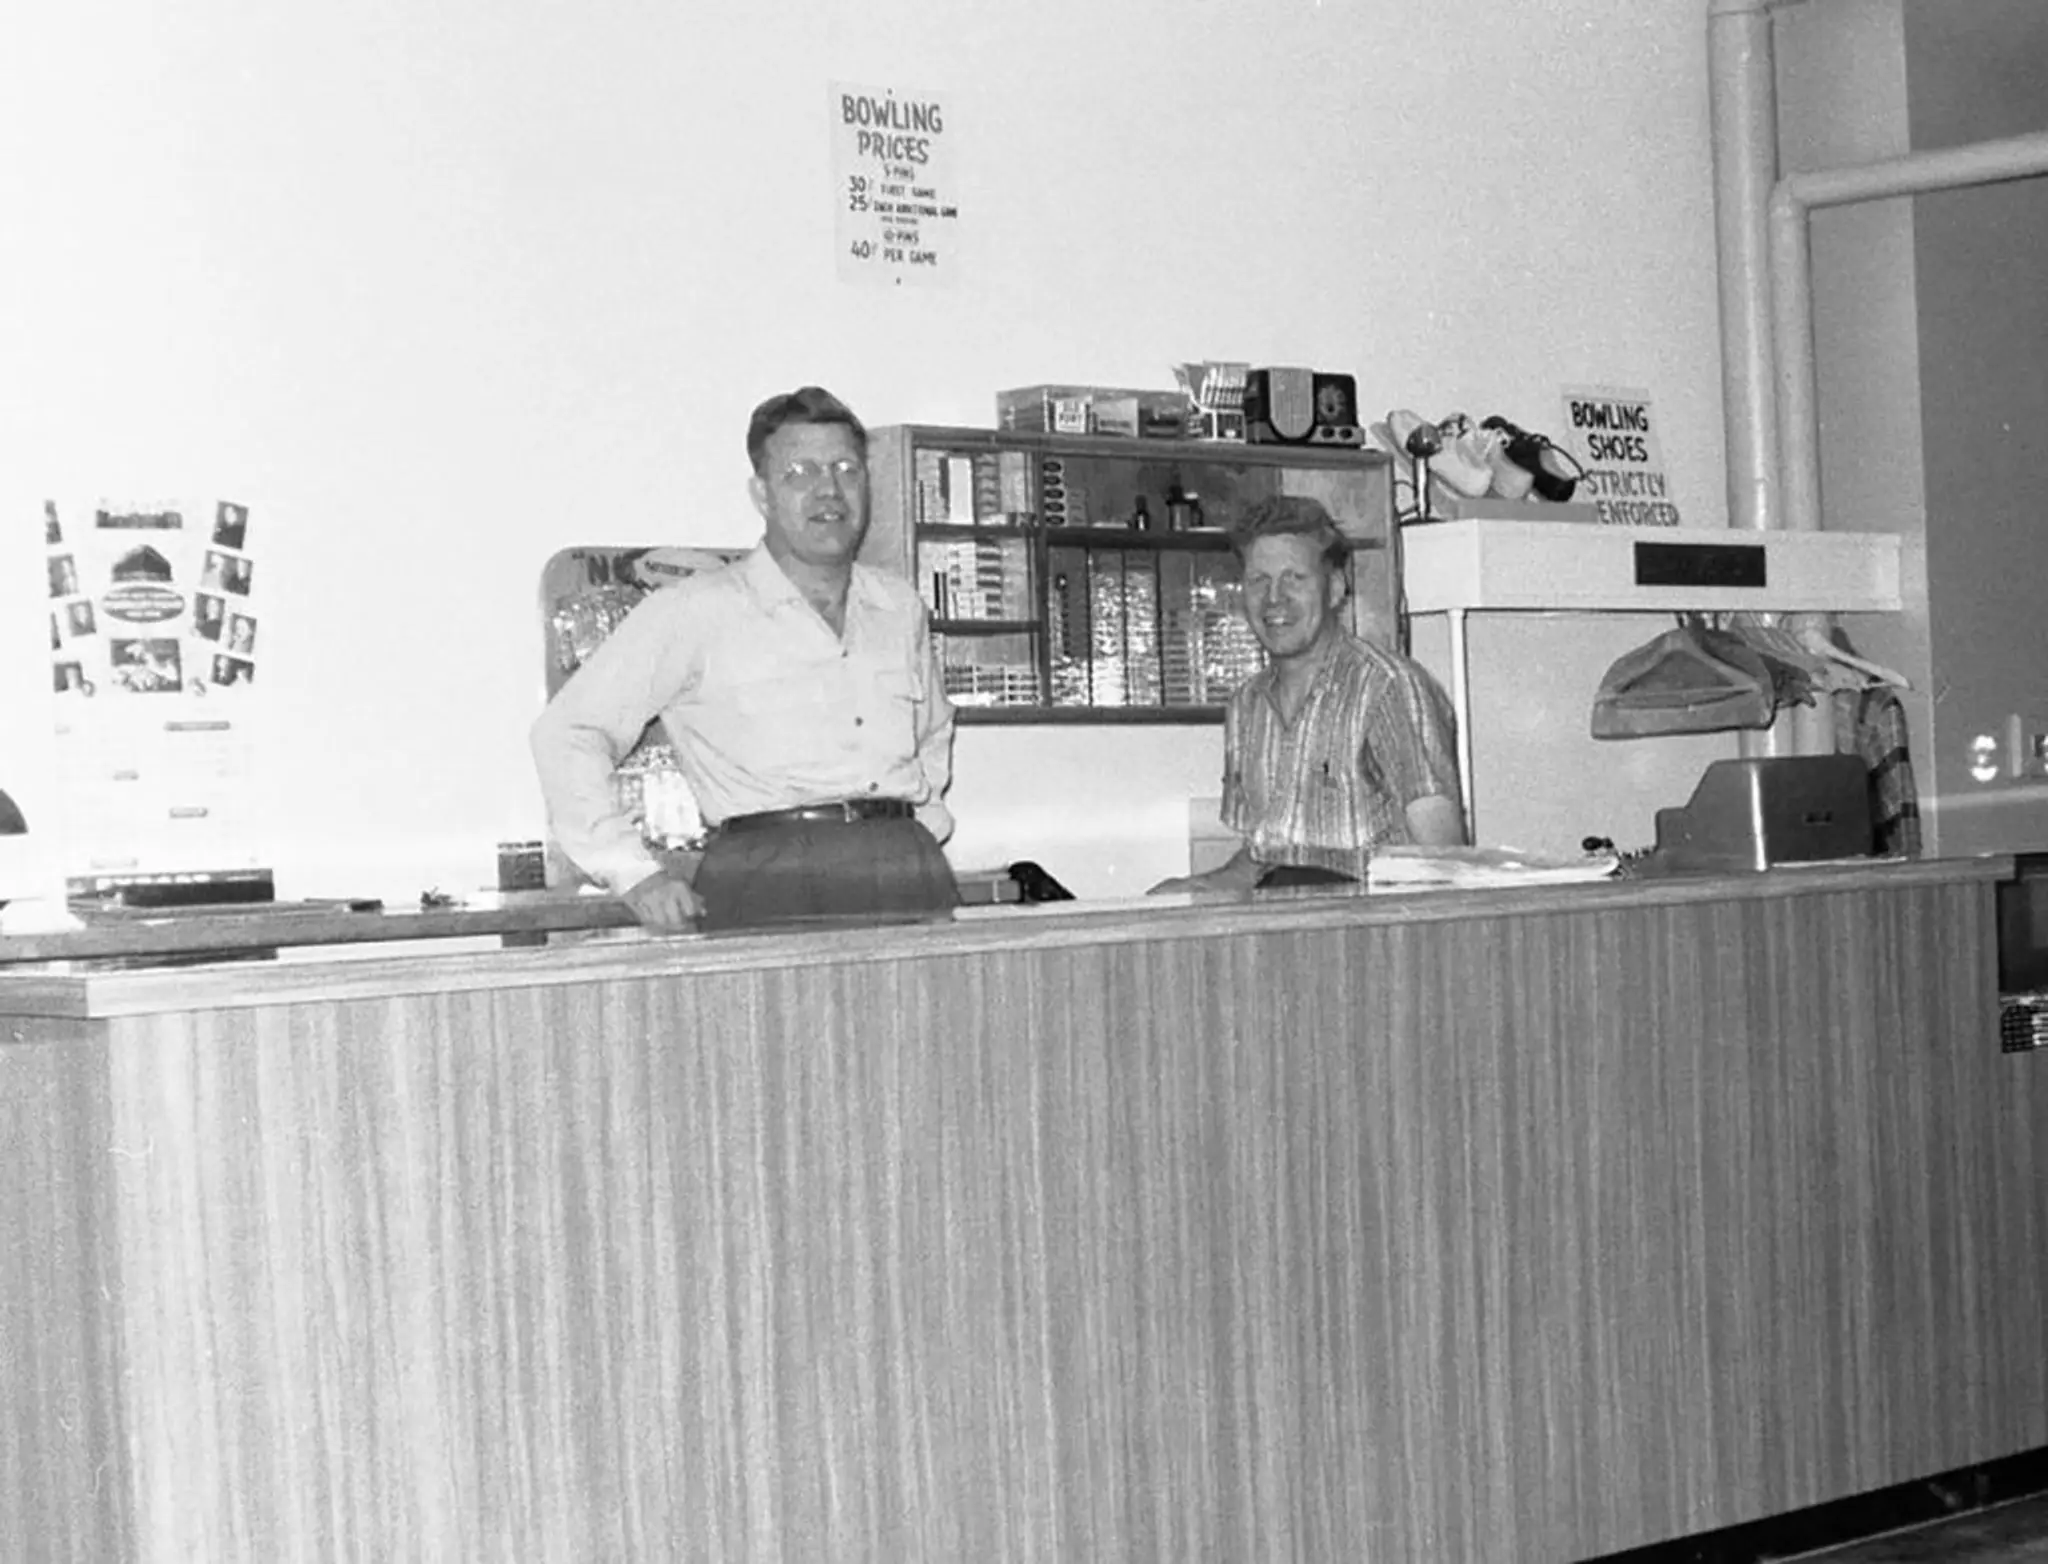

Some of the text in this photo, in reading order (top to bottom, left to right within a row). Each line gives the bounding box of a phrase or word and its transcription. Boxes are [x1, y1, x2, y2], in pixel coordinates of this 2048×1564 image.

[842, 94, 943, 134] BOWLING
[857, 130, 930, 164] PRICES
[883, 247, 903, 263] PER
[909, 249, 937, 266] GAME
[1571, 401, 1649, 432] BOWLING
[1587, 434, 1648, 463] SHOES
[1586, 468, 1666, 496] STRICTLY
[1597, 500, 1681, 527] ENFORCED
